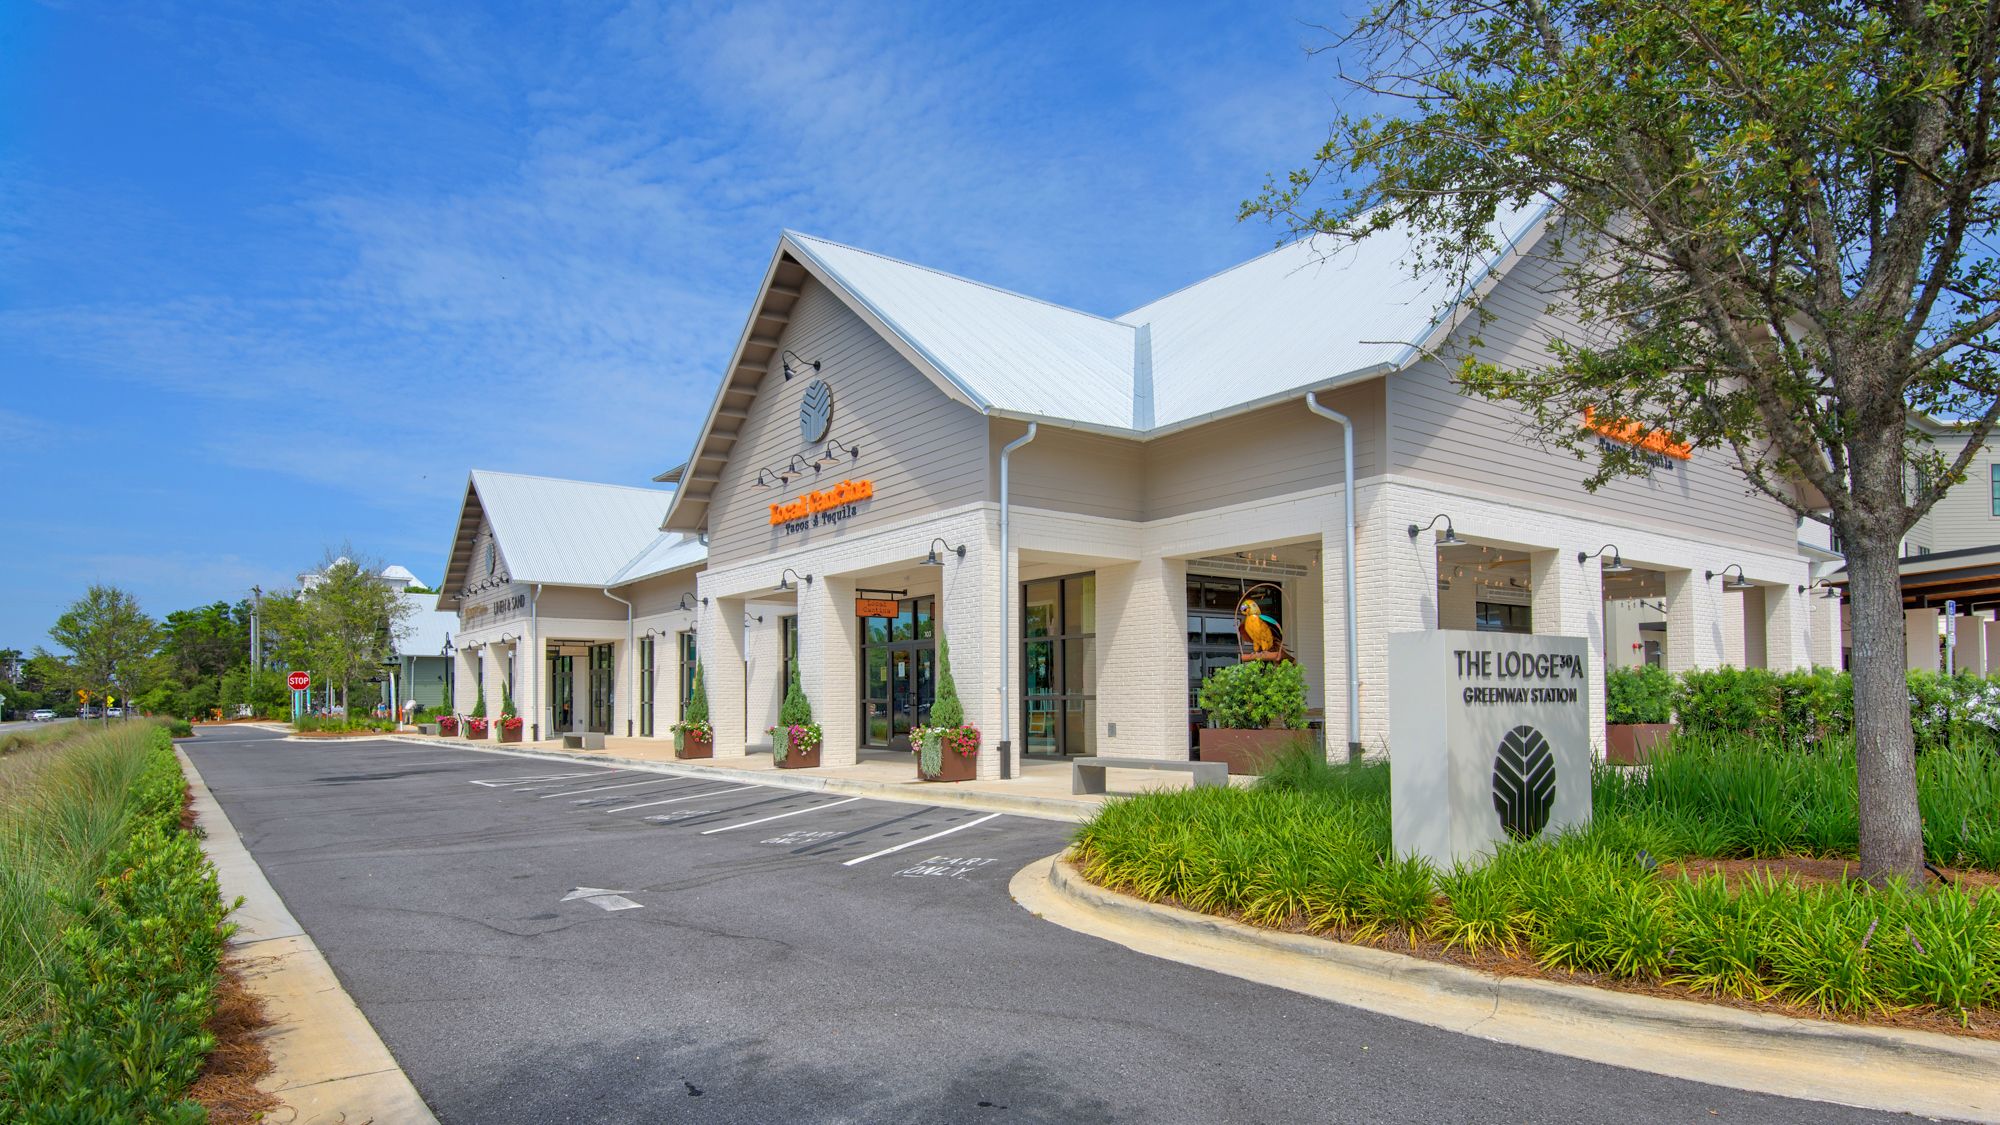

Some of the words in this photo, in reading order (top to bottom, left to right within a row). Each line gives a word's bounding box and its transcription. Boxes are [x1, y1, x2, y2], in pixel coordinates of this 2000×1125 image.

[785, 518, 809, 535] Tacos
[812, 514, 819, 527] &
[822, 506, 857, 526] Tequila
[1454, 650, 1492, 679] THE
[290, 677, 309, 685] STOP
[1463, 687, 1529, 703] GREENWAY
[1530, 688, 1578, 703] STATION
